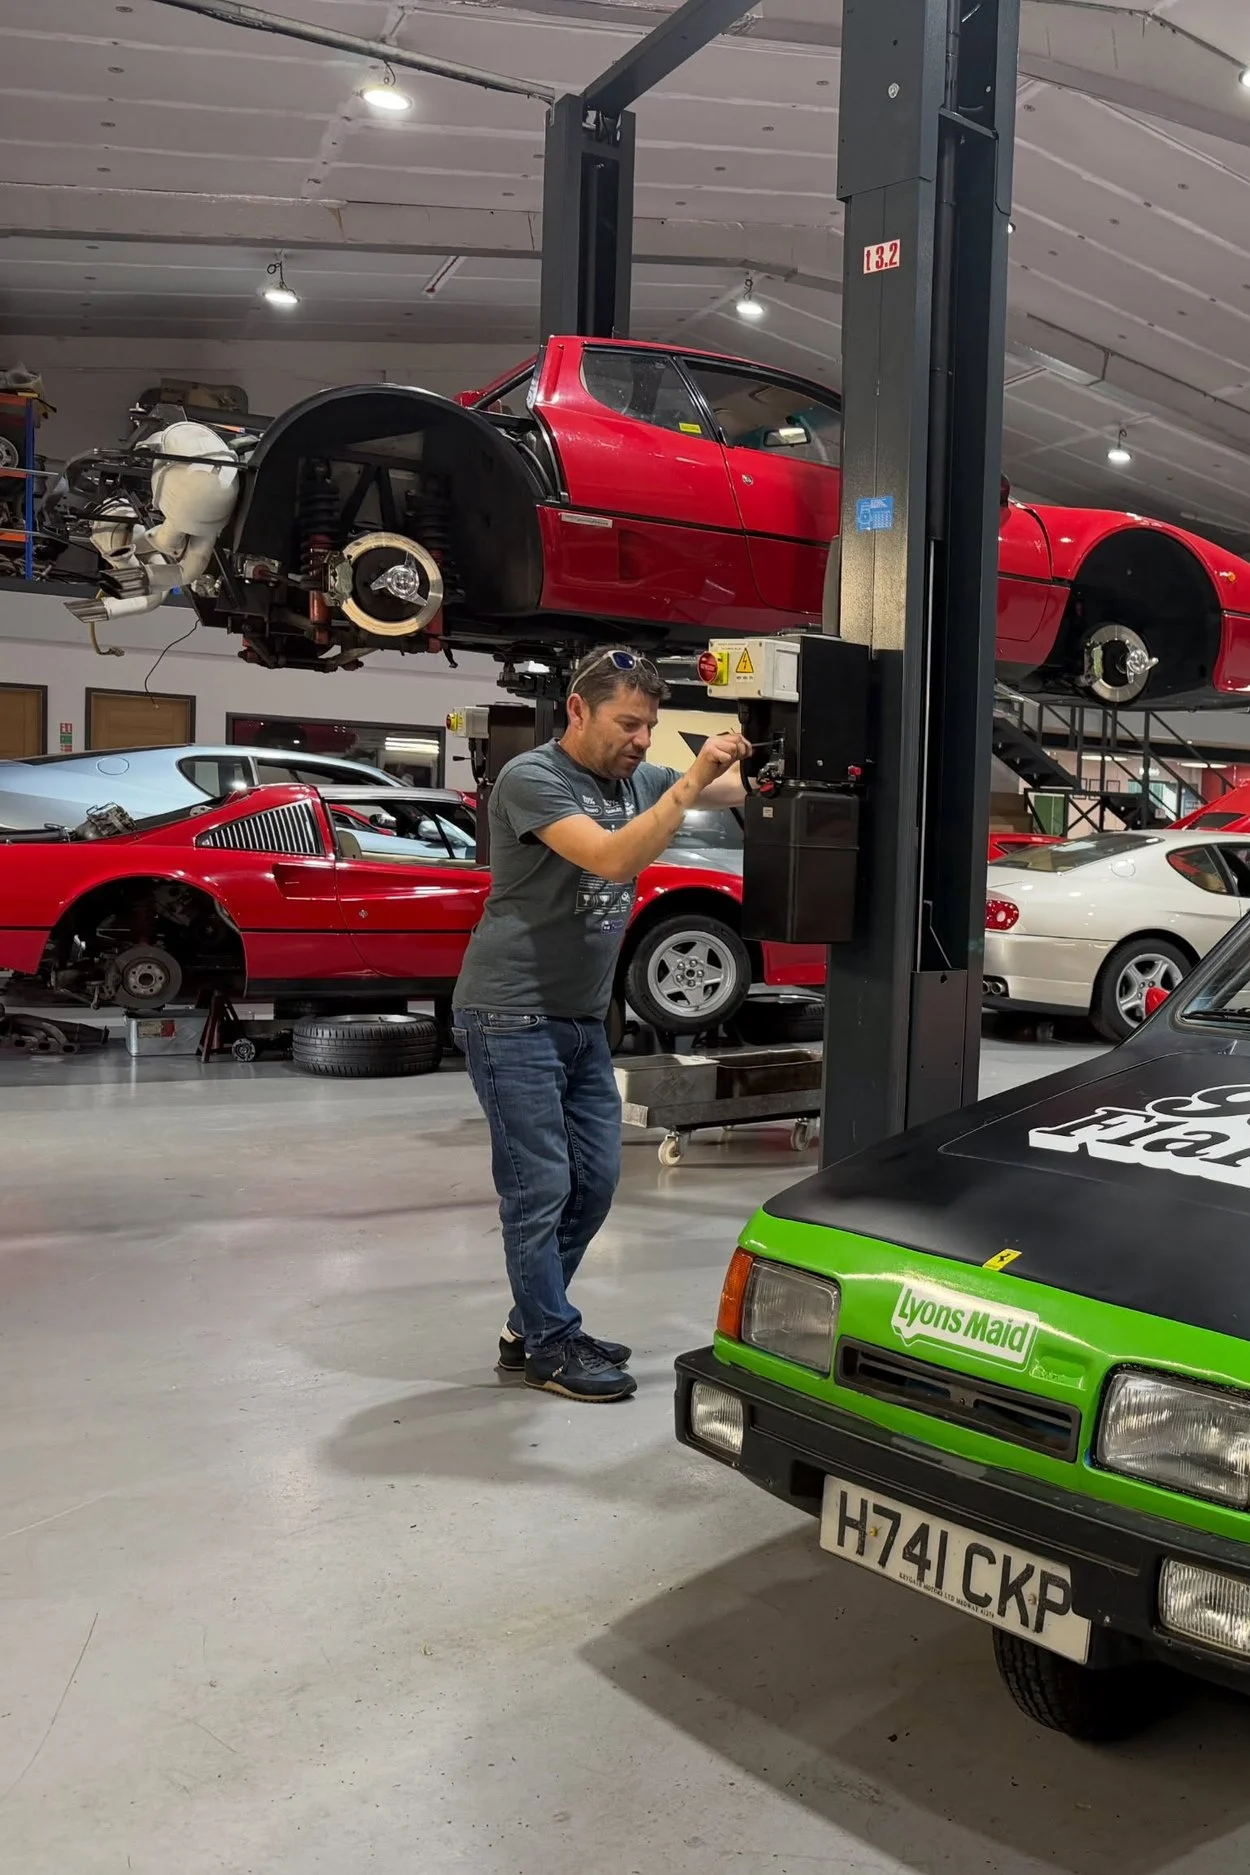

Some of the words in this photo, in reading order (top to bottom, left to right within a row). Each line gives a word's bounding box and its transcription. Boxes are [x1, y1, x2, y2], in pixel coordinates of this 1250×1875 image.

[875, 242, 898, 269] 3.2
[898, 1288, 966, 1334] Lyons
[962, 1311, 1030, 1353] Maid
[836, 1490, 949, 1591] H741
[961, 1542, 1072, 1634] CKP
[944, 1592, 956, 1603] LTD
[955, 1598, 979, 1613] MEDWAY
